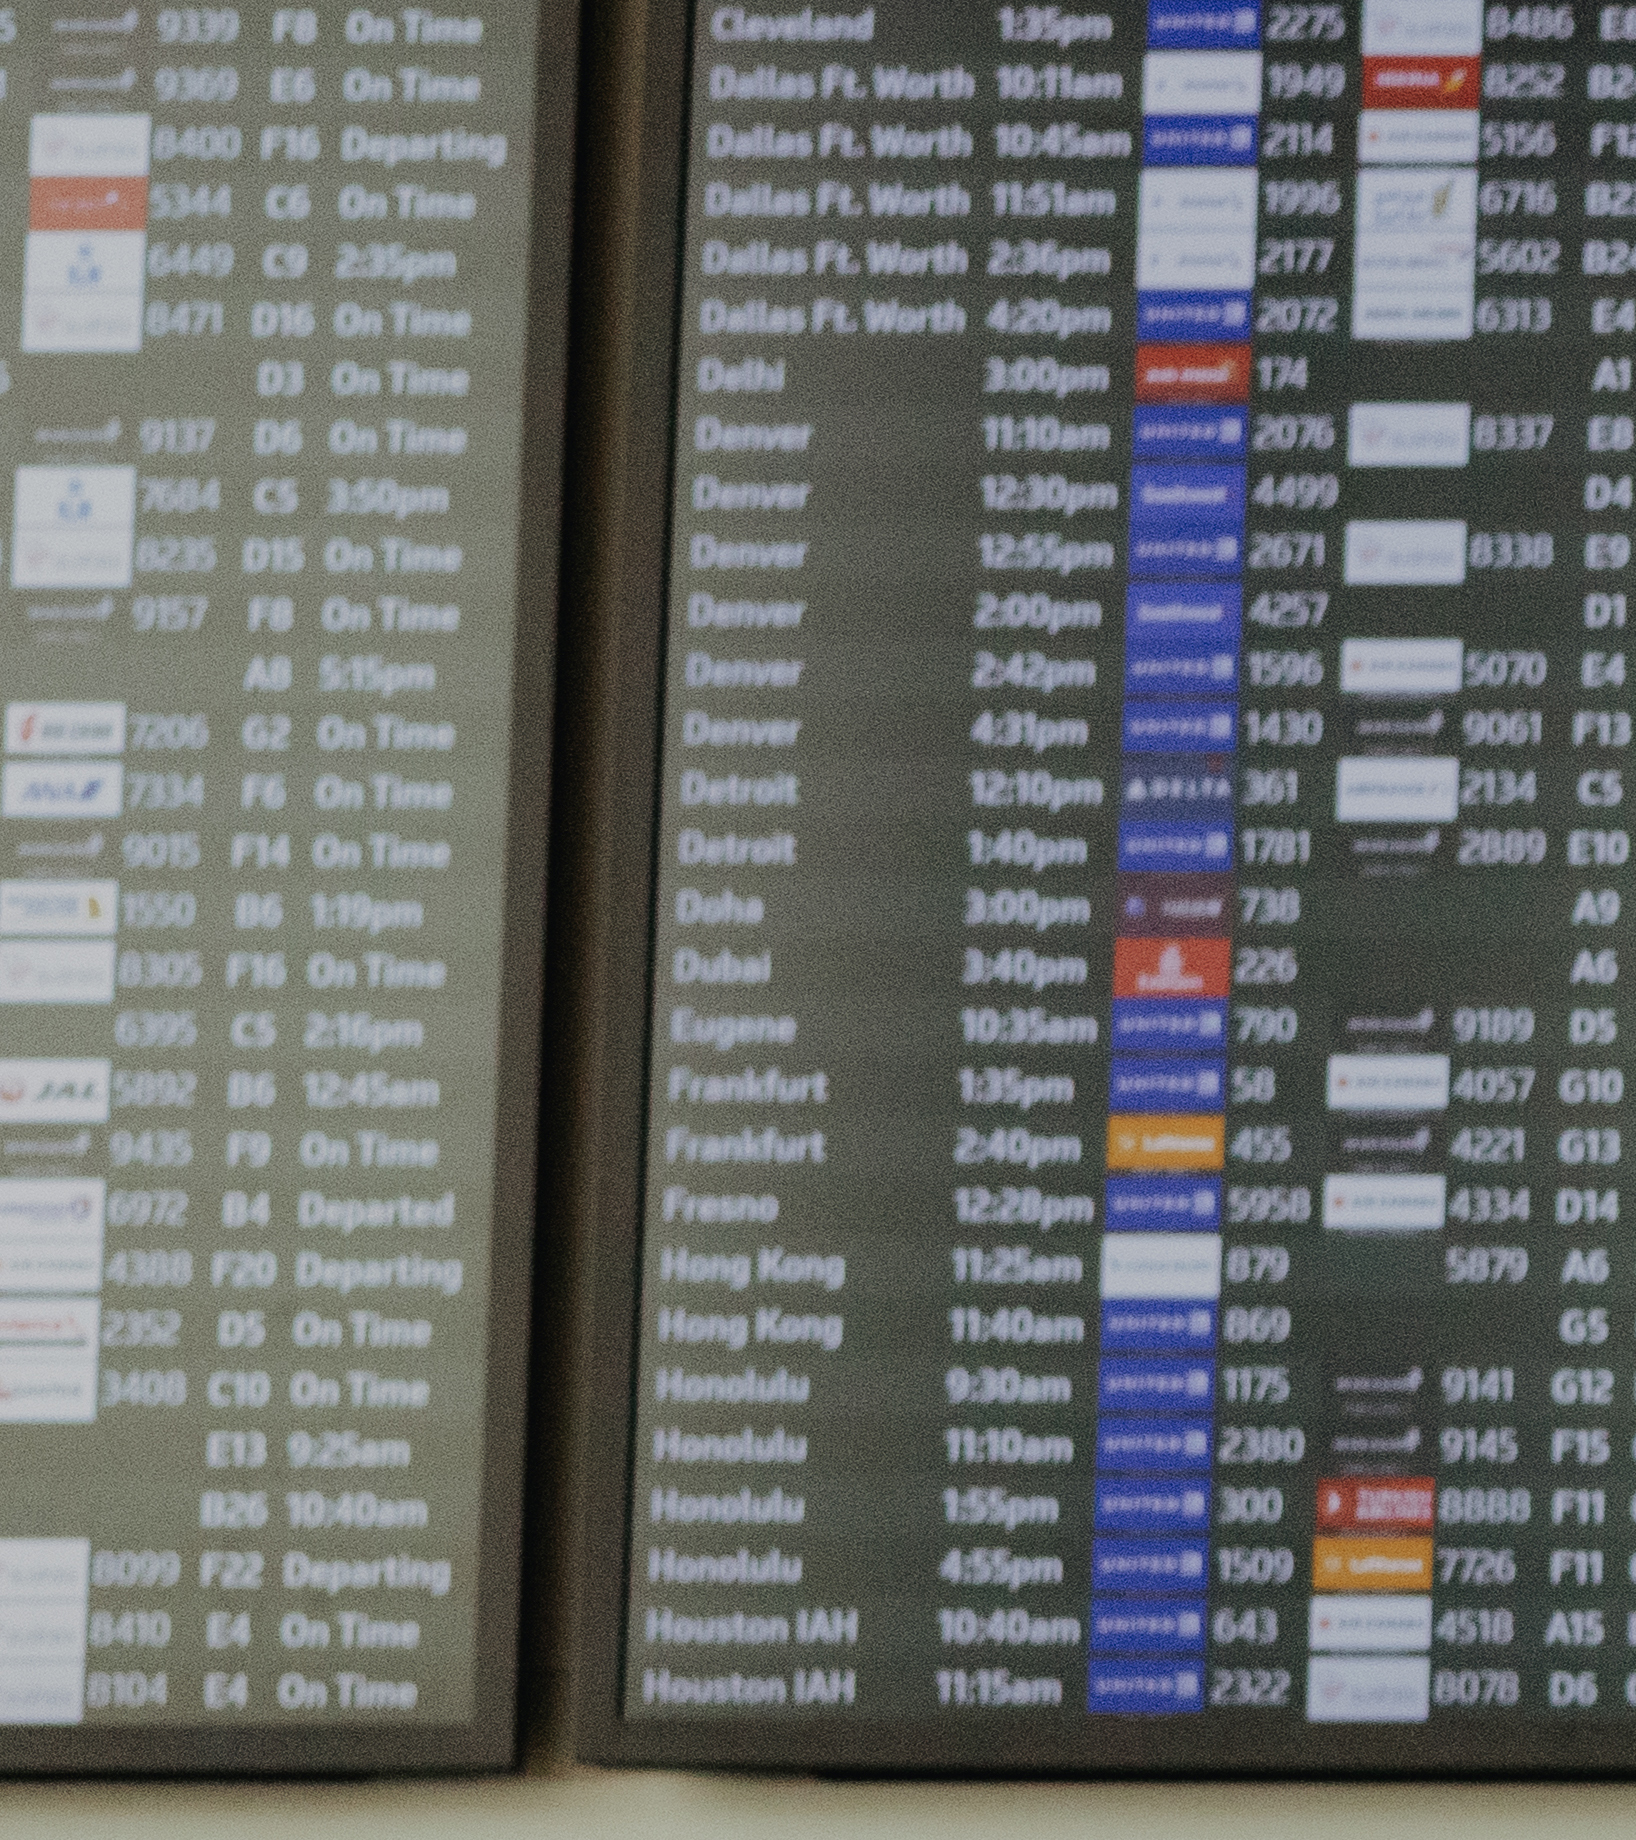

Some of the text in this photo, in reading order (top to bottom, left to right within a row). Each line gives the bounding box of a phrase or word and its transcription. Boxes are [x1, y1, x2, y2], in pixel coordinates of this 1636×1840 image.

[709, 65, 815, 100] Dallas
[873, 66, 975, 100] Worth
[996, 65, 1123, 100] 10:11am
[341, 126, 507, 168] Departing
[335, 243, 457, 284] 2:35pm
[658, 1307, 1084, 1350] Hong Kong 11:40am
[206, 1431, 411, 1467] E13 9:25am
[645, 1608, 789, 1644] Houston
[796, 1609, 858, 1642] IAH
[938, 1608, 1081, 1644] 10:40am
[277, 1672, 328, 1708] On
[336, 1672, 417, 1708] Time
